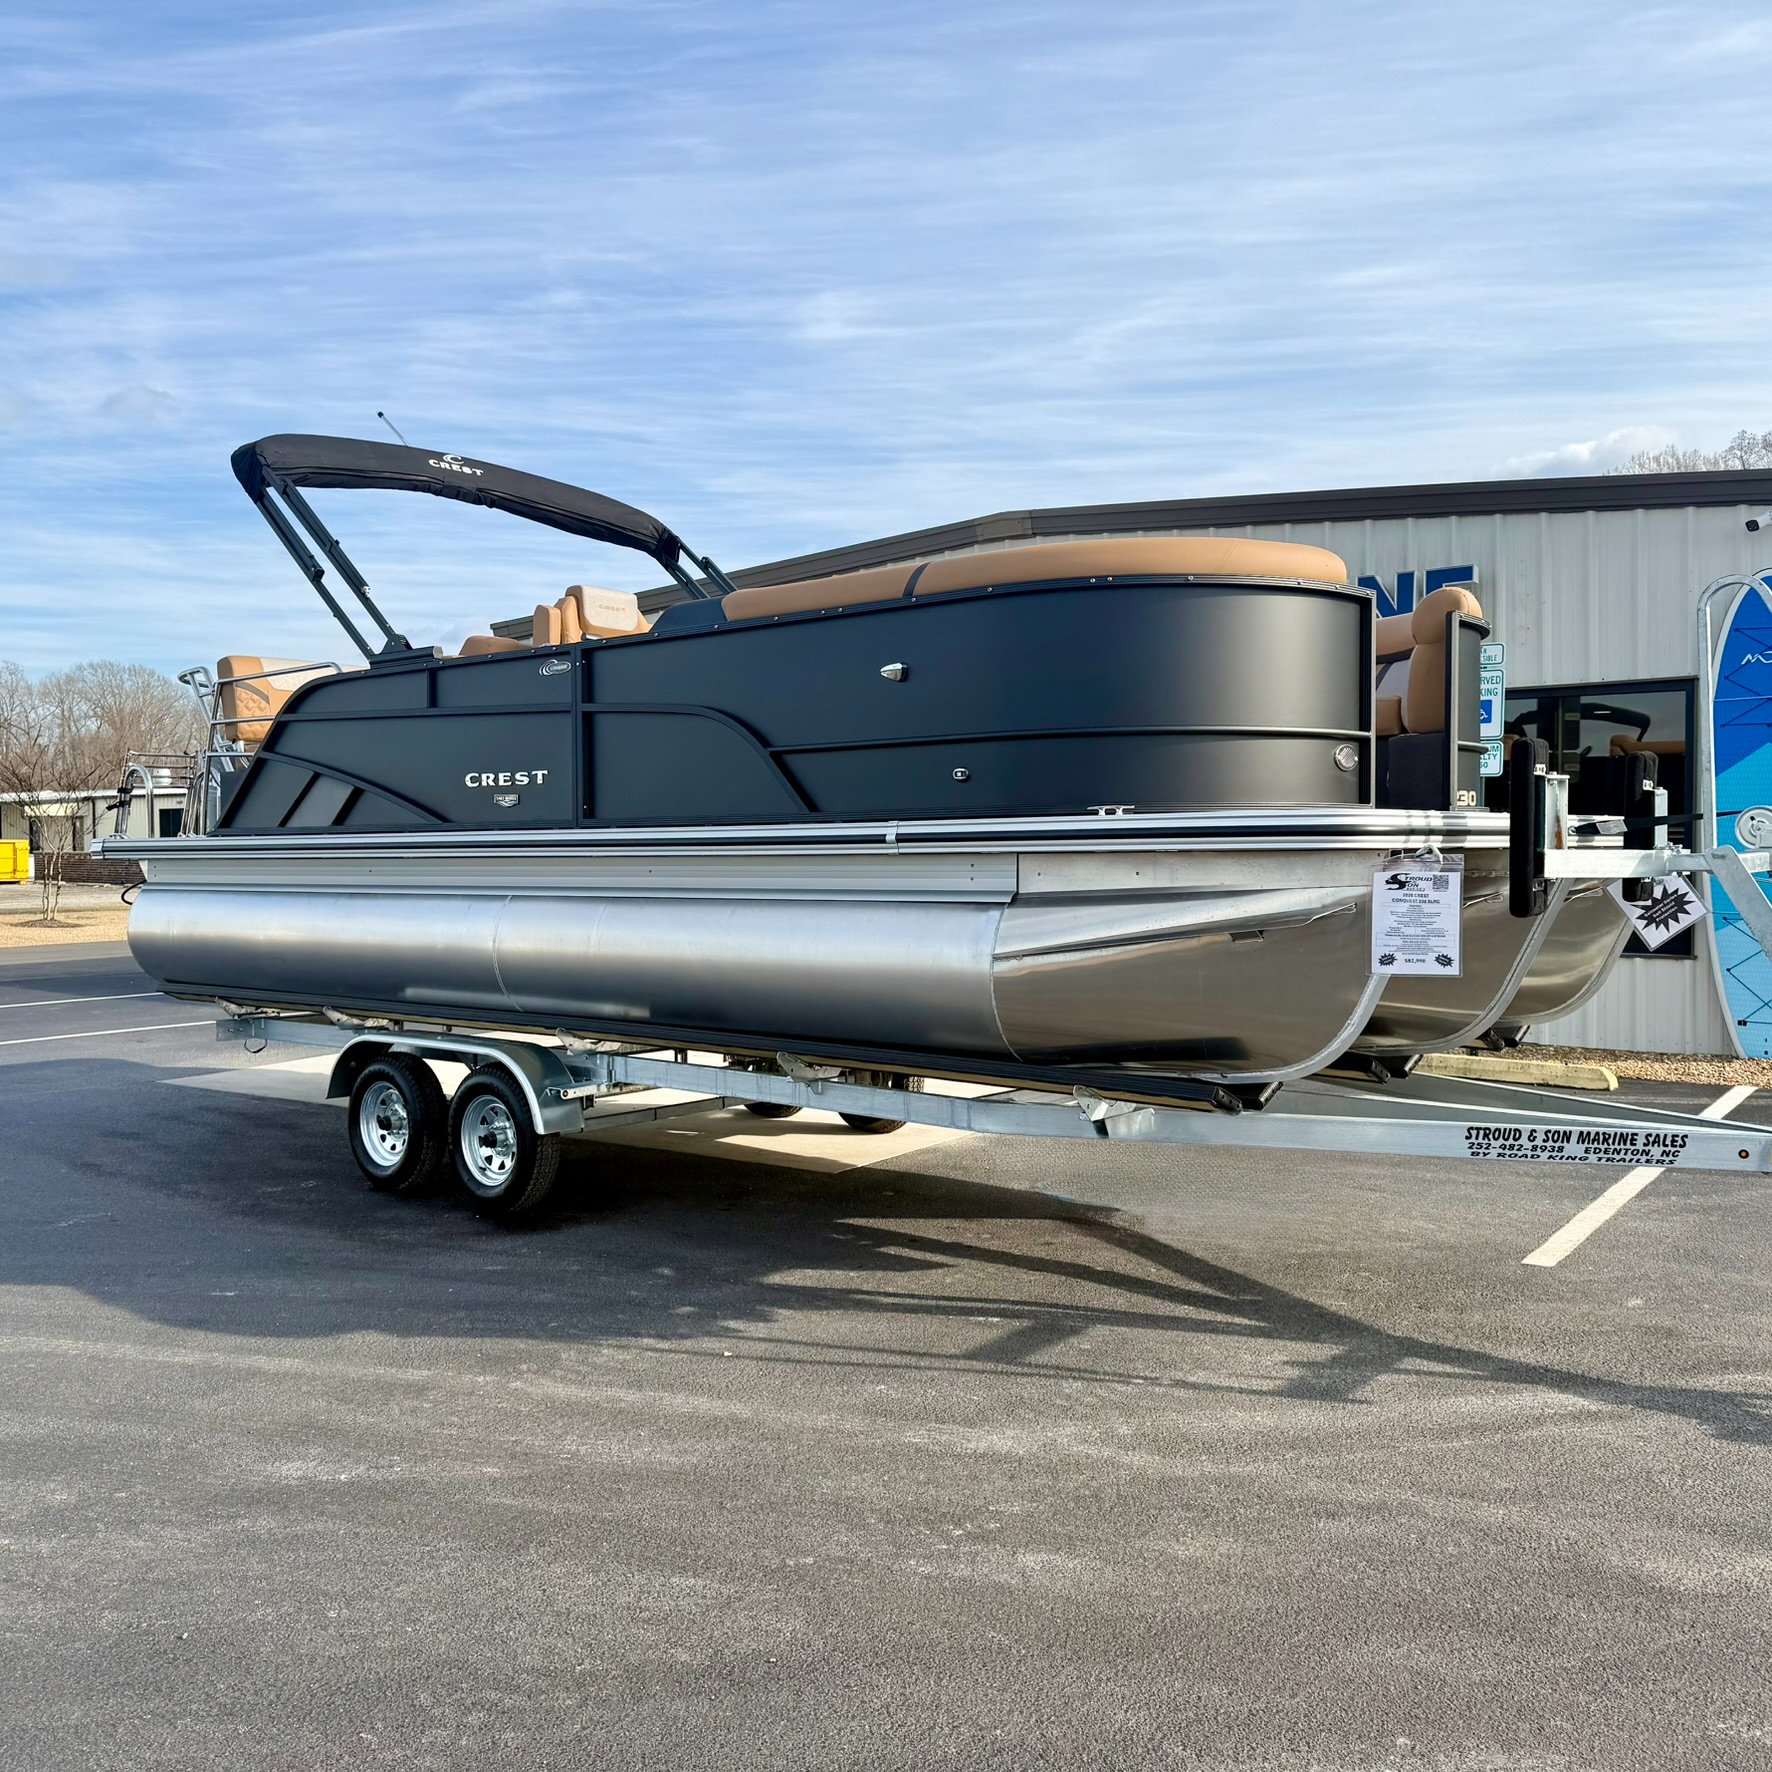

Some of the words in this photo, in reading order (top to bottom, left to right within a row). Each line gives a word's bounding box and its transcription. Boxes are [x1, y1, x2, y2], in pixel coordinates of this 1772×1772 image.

[429, 459, 483, 476] CREST
[465, 770, 548, 787] CREST
[1465, 1126, 1522, 1142] STROUD
[1527, 1128, 1537, 1143] &
[1542, 1129, 1573, 1144] SON
[1576, 1130, 1639, 1146] MARINE
[1642, 1132, 1688, 1148] SALES
[1467, 1142, 1565, 1153] 252-482-8938
[1584, 1146, 1654, 1158] EDENTON,
[1660, 1149, 1680, 1158] NC
[1496, 1152, 1541, 1160] ROAD
[1547, 1154, 1590, 1162] KING
[1596, 1156, 1677, 1165] TRAILERS
